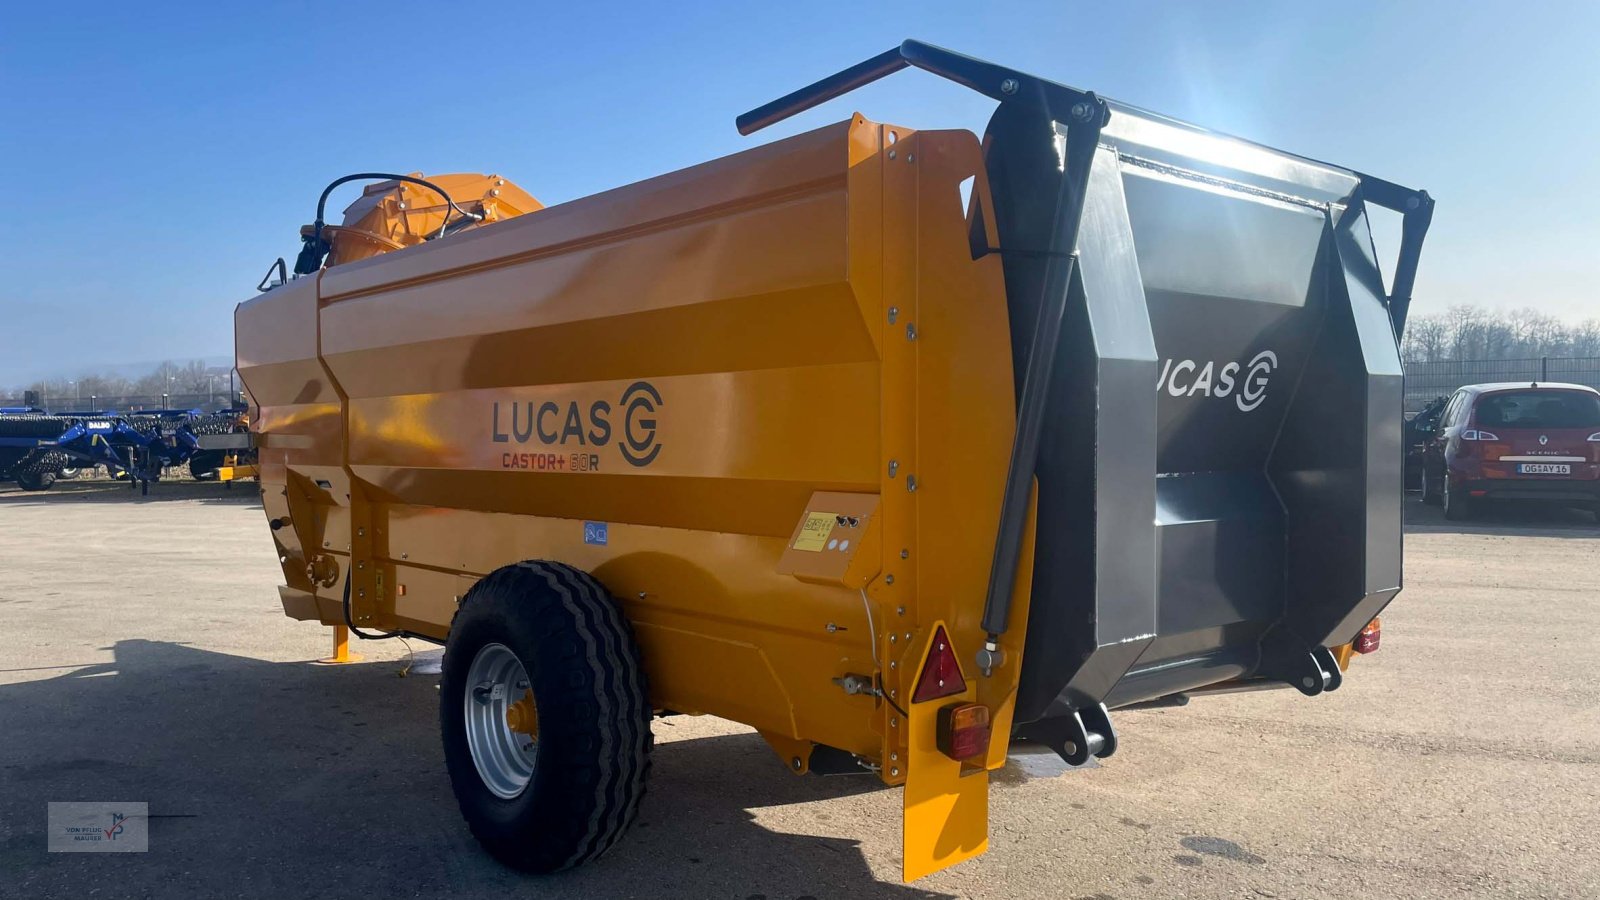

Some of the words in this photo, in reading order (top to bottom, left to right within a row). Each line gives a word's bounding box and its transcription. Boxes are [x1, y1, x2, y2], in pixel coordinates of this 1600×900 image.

[1157, 359, 1240, 398] CAS
[88, 421, 111, 429] DALBO
[493, 400, 611, 446] LUCAS
[502, 452, 565, 470] CASTOR+
[570, 453, 599, 472] 60R
[1524, 464, 1537, 473] OG
[1543, 465, 1555, 473] AY
[1556, 465, 1567, 473] 16
